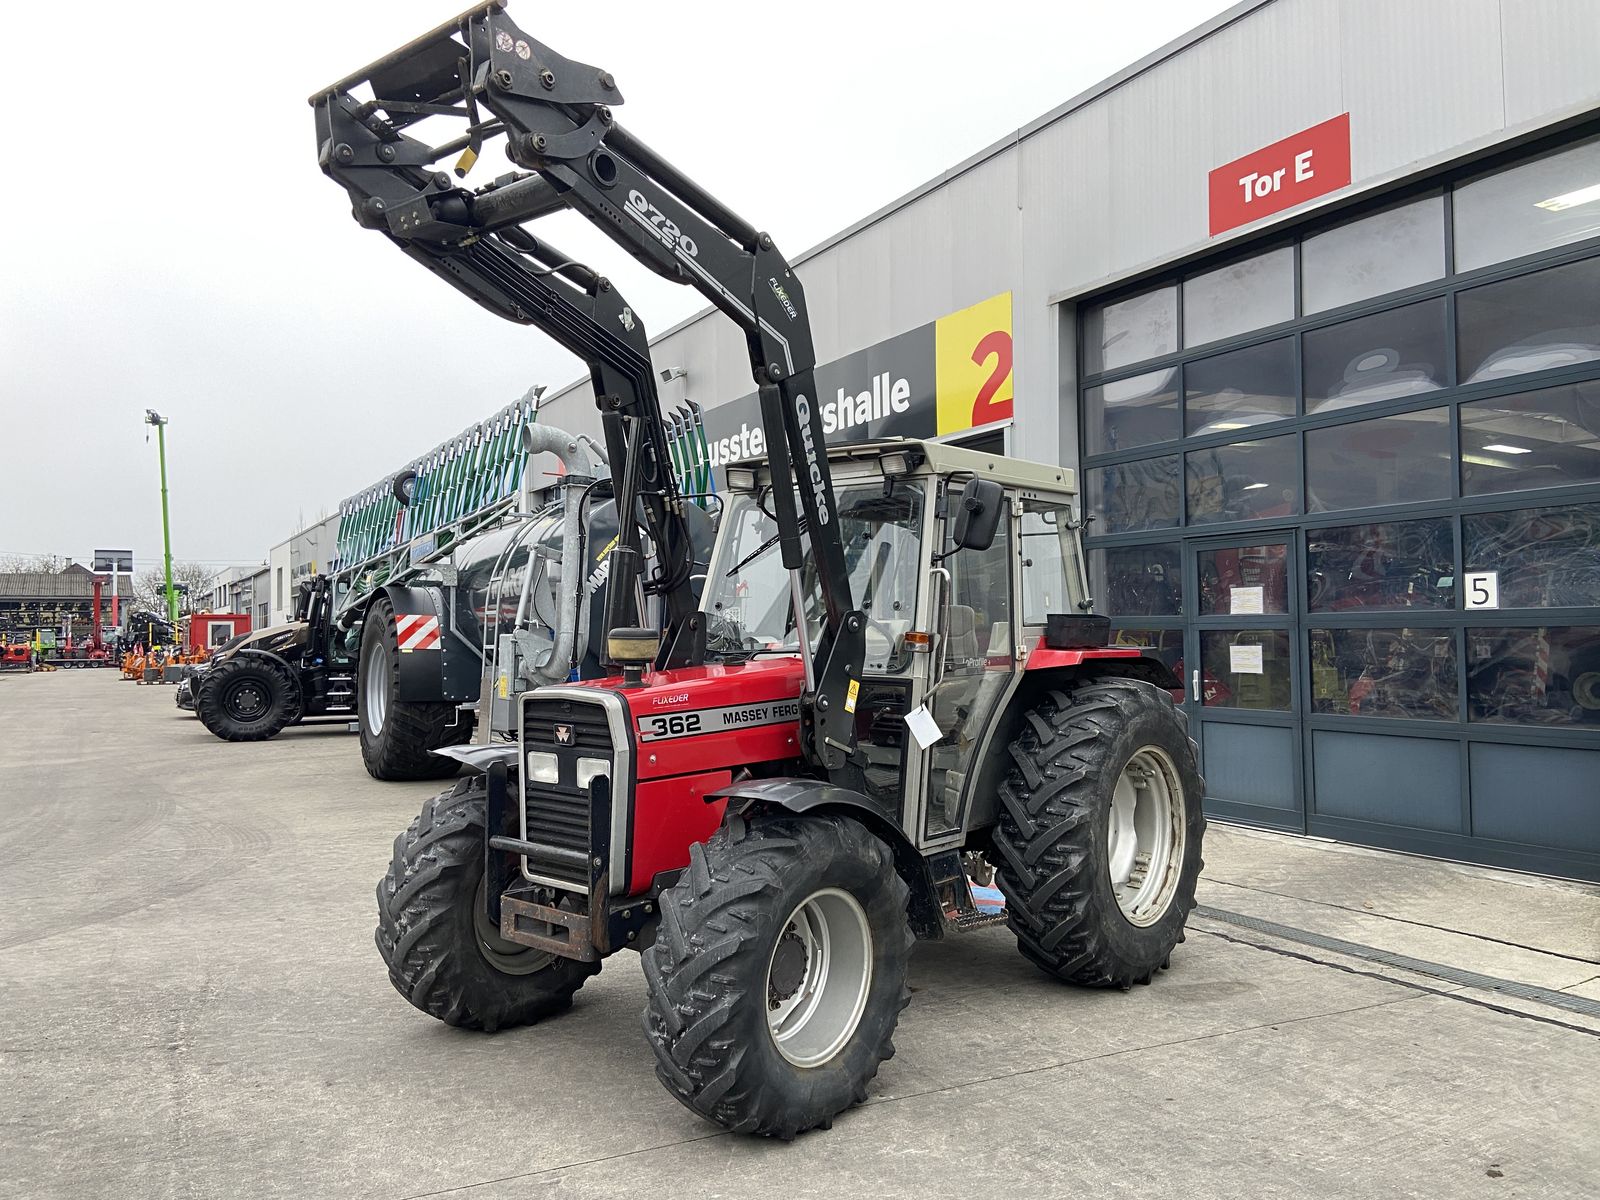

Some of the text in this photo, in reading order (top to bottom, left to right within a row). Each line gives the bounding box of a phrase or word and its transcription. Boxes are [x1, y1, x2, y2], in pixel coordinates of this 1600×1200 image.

[1238, 149, 1315, 204] Tor E
[628, 189, 699, 257] Q720
[970, 330, 1013, 428] 2
[795, 393, 830, 526] Quicke
[1472, 577, 1490, 606] 5
[651, 703, 800, 737] 362 MASSEY FERG
